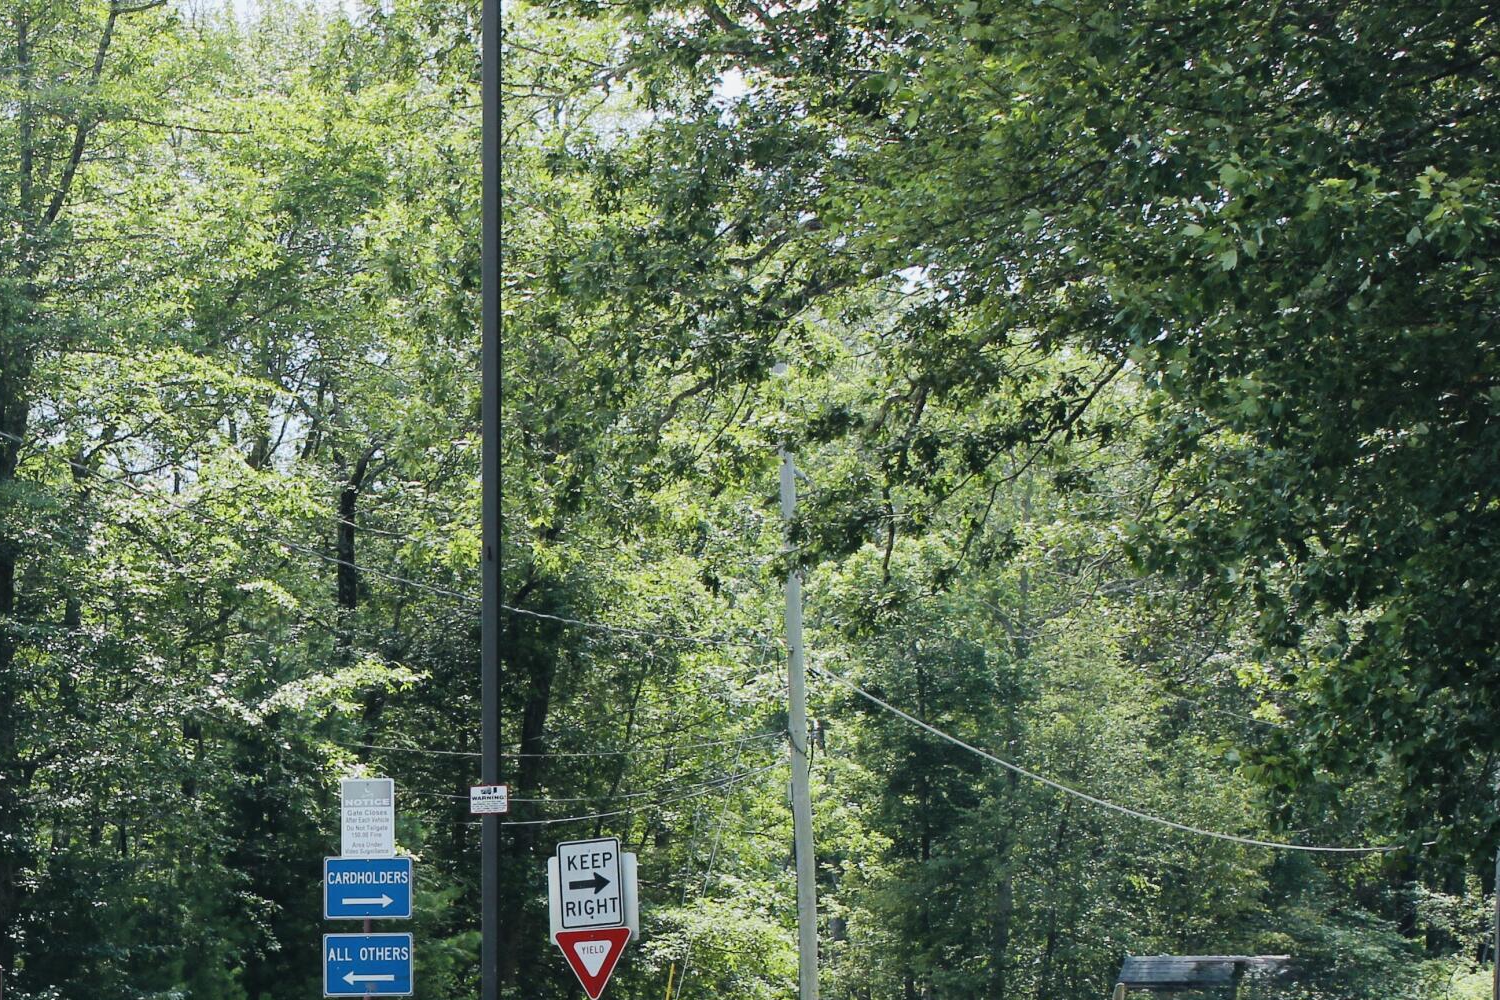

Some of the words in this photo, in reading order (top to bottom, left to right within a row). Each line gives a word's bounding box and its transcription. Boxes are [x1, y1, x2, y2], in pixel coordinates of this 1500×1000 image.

[568, 852, 612, 871] KEEP
[328, 872, 408, 884] CARDHOLDERS
[566, 897, 618, 917] RIGHT
[328, 948, 352, 961] ALL
[359, 947, 409, 961] OTHERS
[582, 946, 604, 954] YIELD
